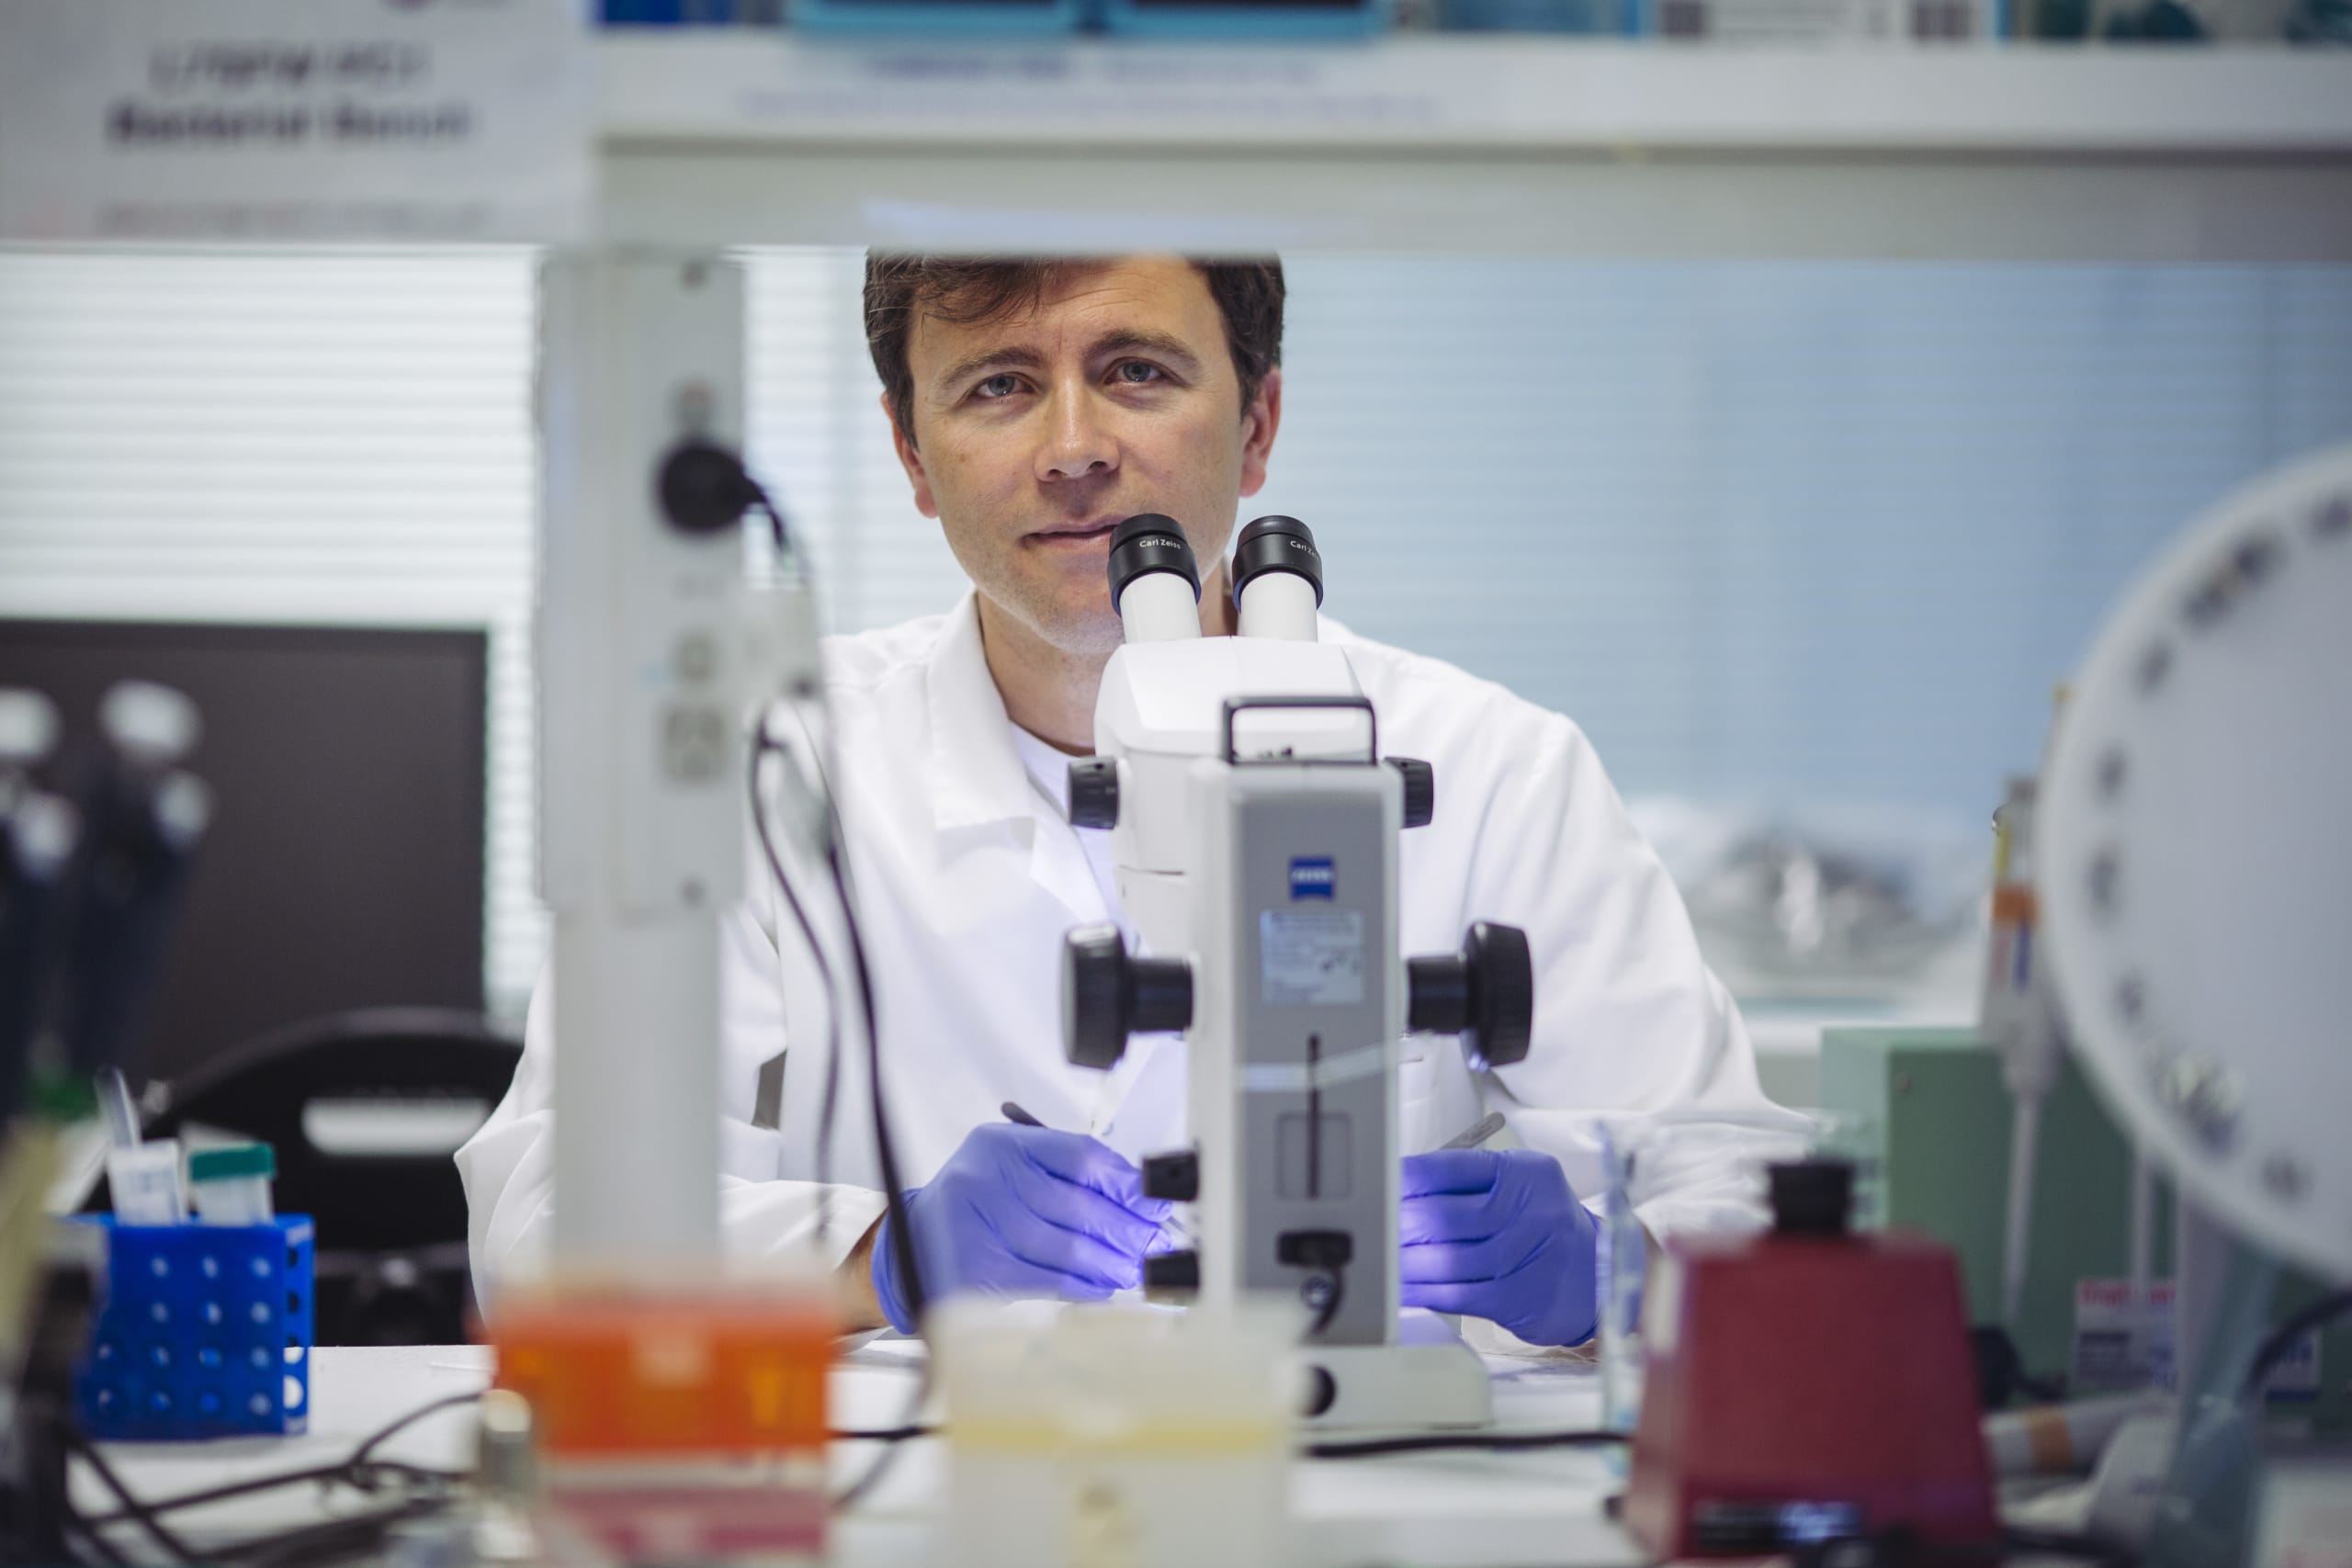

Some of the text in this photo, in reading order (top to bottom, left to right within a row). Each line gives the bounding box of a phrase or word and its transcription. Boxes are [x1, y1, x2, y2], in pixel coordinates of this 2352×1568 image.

[1139, 538, 1182, 549] Carl Zeiss
[1290, 540, 1306, 551] Carl
